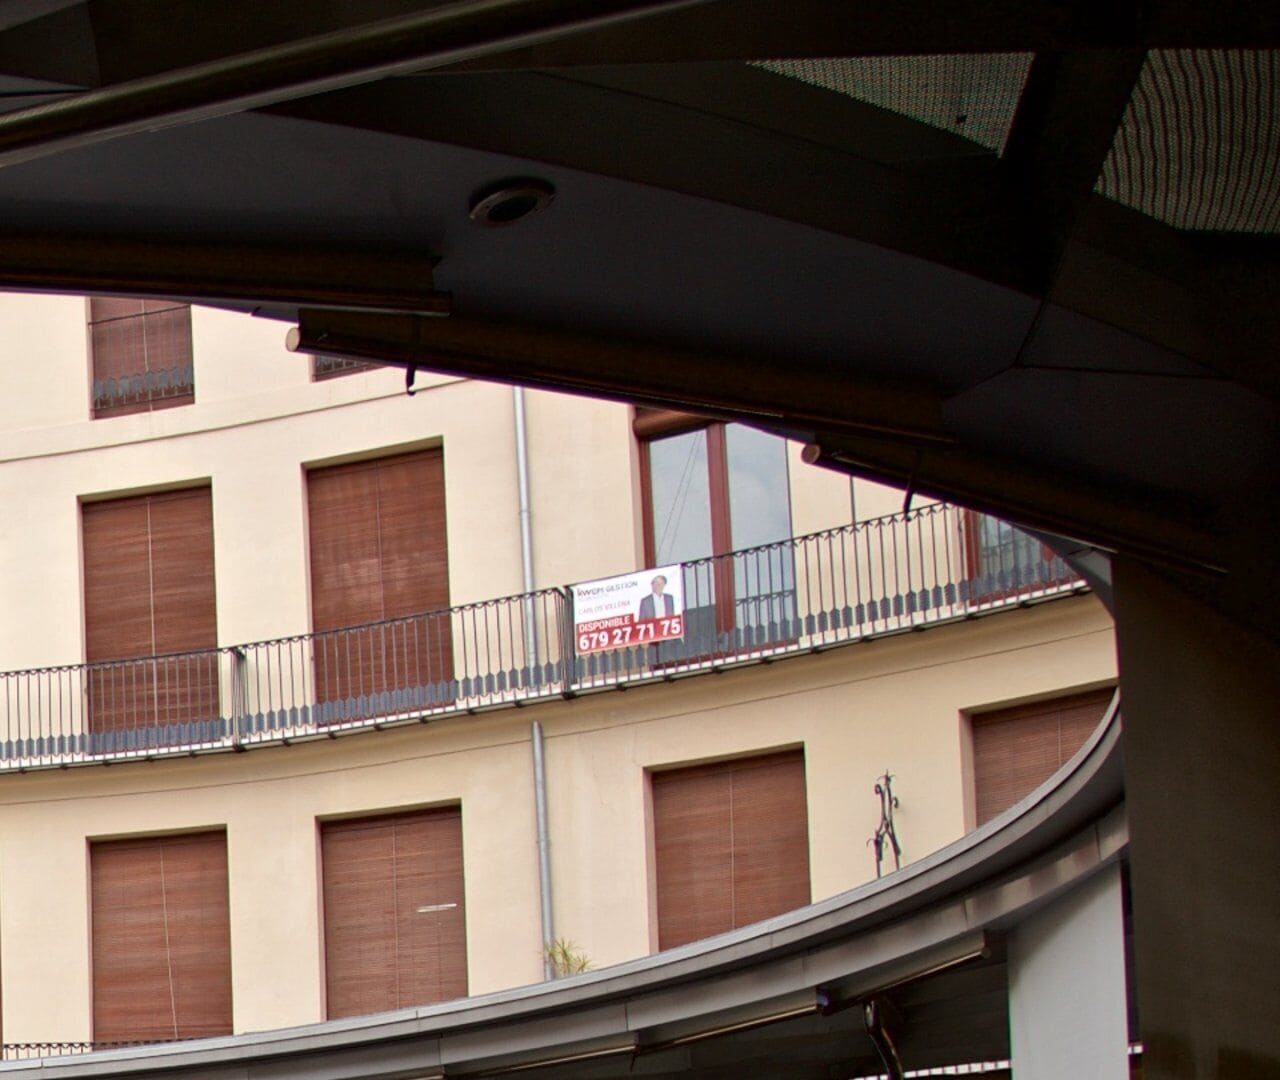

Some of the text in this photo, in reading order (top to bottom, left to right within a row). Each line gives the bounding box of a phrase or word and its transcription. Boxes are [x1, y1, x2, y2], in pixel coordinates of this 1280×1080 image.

[578, 615, 631, 633] DISPONIBLE
[579, 618, 681, 650] 679 27 71 75
